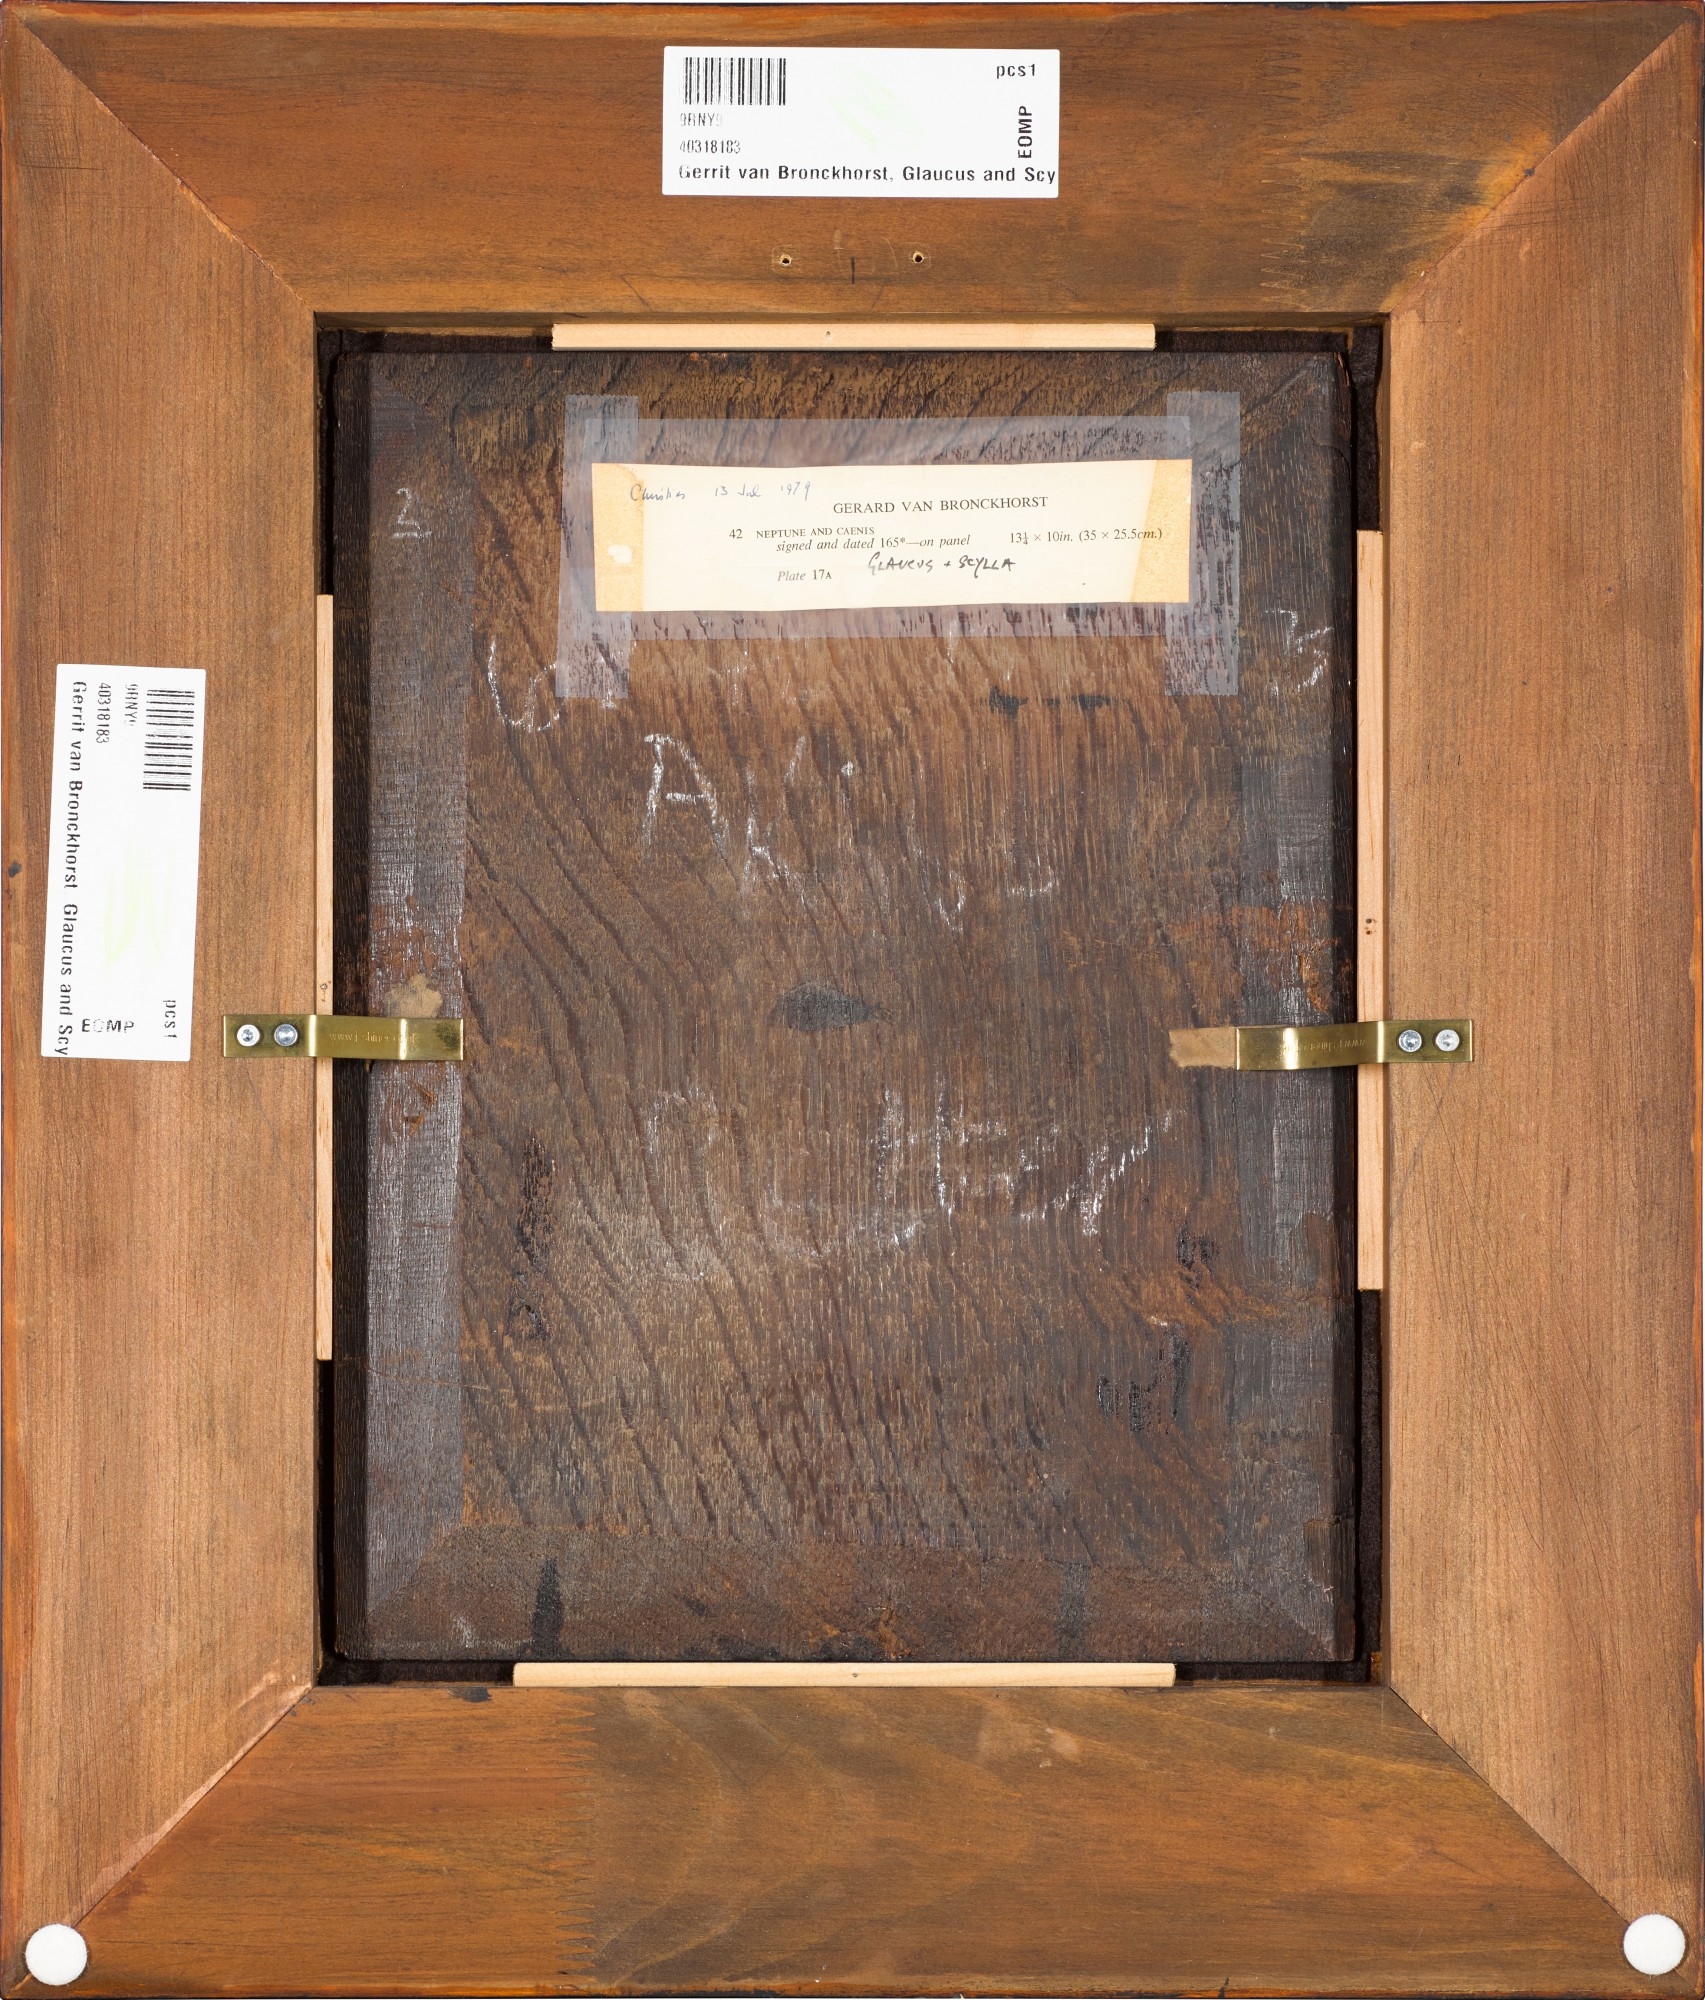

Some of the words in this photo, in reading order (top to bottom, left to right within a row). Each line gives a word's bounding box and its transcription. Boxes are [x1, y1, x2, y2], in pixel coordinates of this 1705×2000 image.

[996, 63, 1037, 78] pcs1
[679, 139, 741, 155] 40318183
[1018, 105, 1033, 159] EOMP
[679, 164, 731, 180] Gerrit
[738, 168, 770, 180] van
[778, 165, 894, 183] Bronckhorst,
[902, 165, 976, 182] Glaucus
[983, 167, 1016, 182] and
[1024, 166, 1056, 185] Scy
[833, 502, 895, 514] GERARD
[902, 500, 933, 513] VAN
[940, 496, 1049, 511] BRONCKHORST
[729, 528, 743, 540] 42
[756, 528, 806, 539] NEPTUNE
[811, 527, 833, 537] AND
[836, 526, 875, 536] CAENIS
[776, 538, 813, 554] signed
[816, 540, 838, 550] and
[843, 538, 875, 550] dated
[939, 534, 971, 549] panel
[1047, 530, 1074, 543] 10in.
[1078, 529, 1097, 543] (35
[1113, 527, 1163, 541] 25.5cm.)
[777, 570, 807, 582] Plate
[71, 681, 88, 733] Gerrit
[95, 682, 112, 745] 40318183
[69, 740, 82, 772] van
[60, 903, 78, 976] Glaucus
[58, 983, 72, 1016] and
[162, 999, 178, 1039] pcs1
[55, 1025, 73, 1056] Scy
